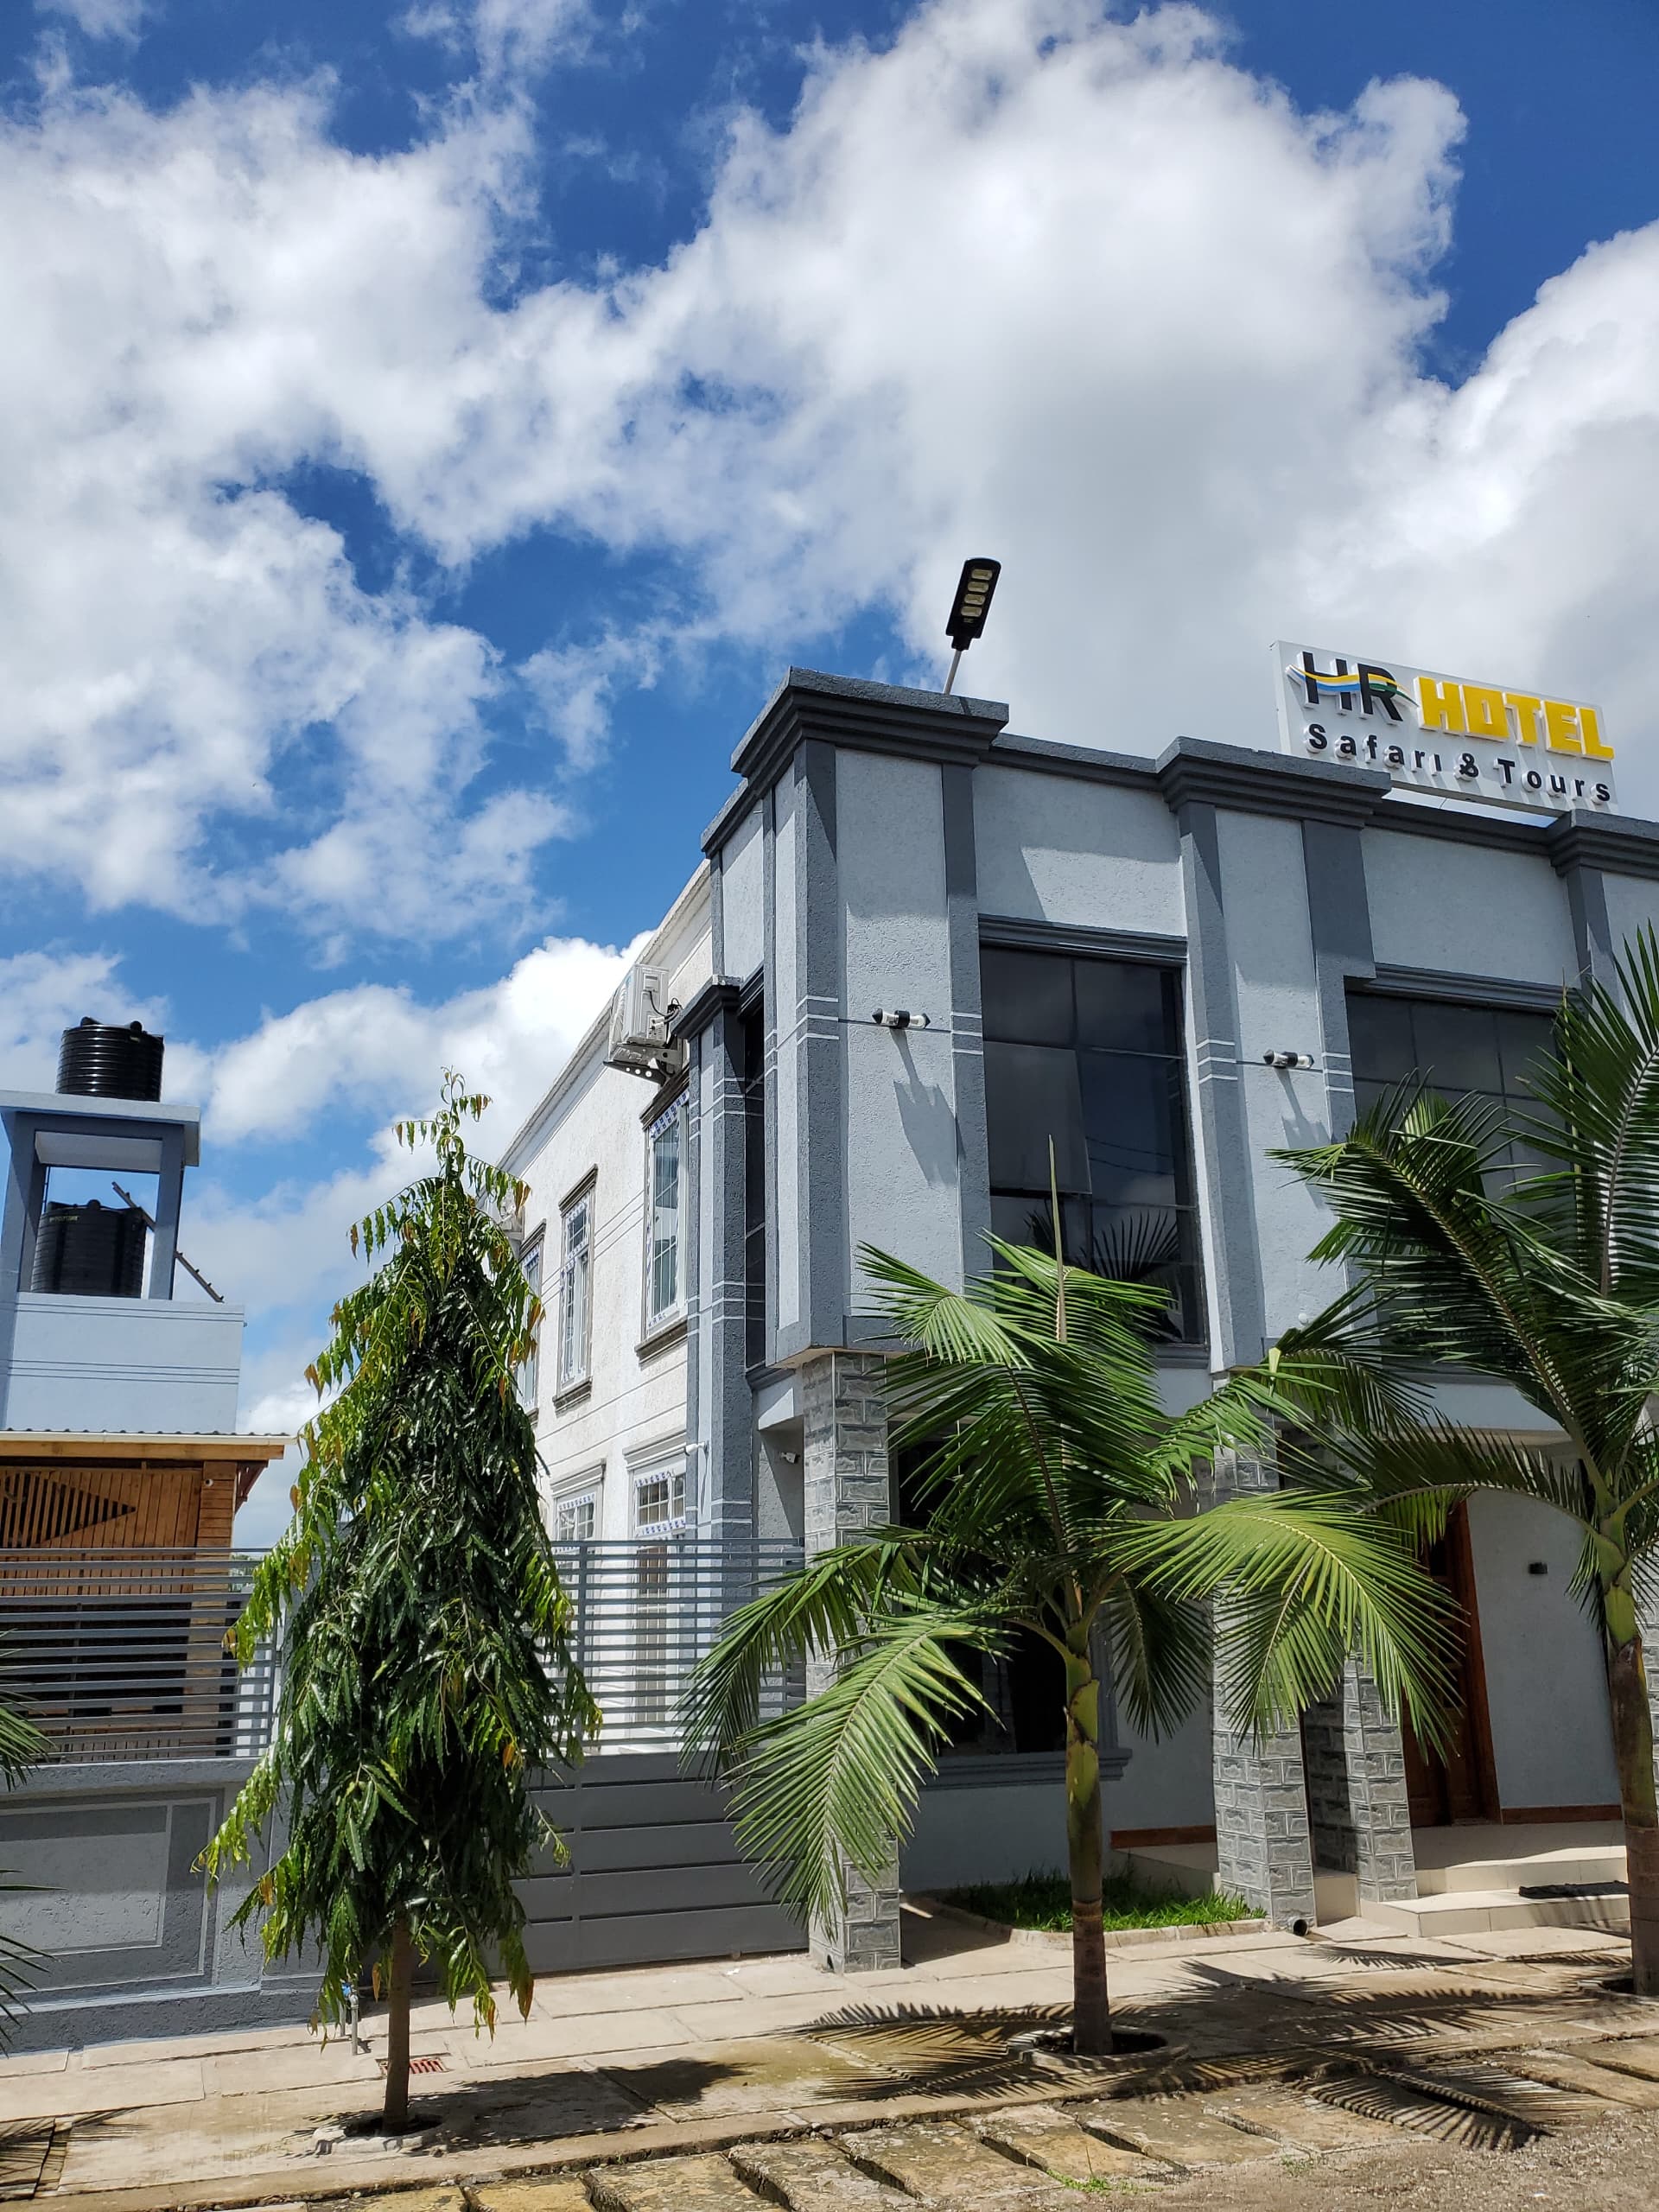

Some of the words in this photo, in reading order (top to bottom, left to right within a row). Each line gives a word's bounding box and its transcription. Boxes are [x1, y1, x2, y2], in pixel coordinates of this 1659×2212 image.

[1300, 651, 1404, 722] HR
[1415, 676, 1615, 760] HOTEL
[1306, 723, 1442, 772] Safari
[1457, 752, 1480, 779] &
[1496, 758, 1611, 803] Tours
